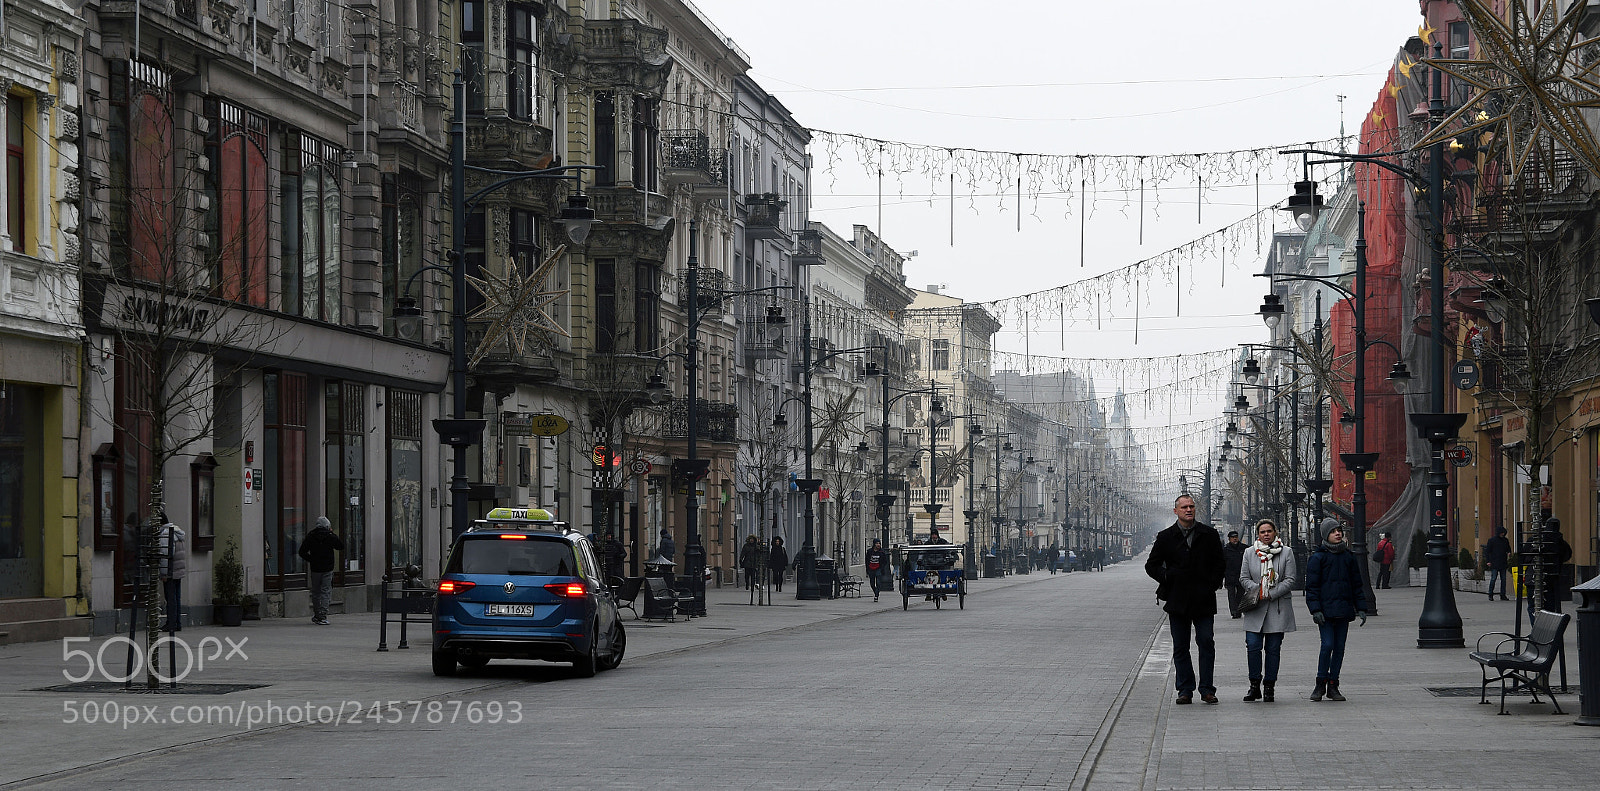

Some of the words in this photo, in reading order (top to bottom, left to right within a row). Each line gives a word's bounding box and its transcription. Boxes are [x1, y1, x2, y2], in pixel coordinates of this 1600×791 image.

[512, 510, 528, 519] TAXI
[491, 605, 502, 613] EL
[506, 605, 532, 613] 116XS
